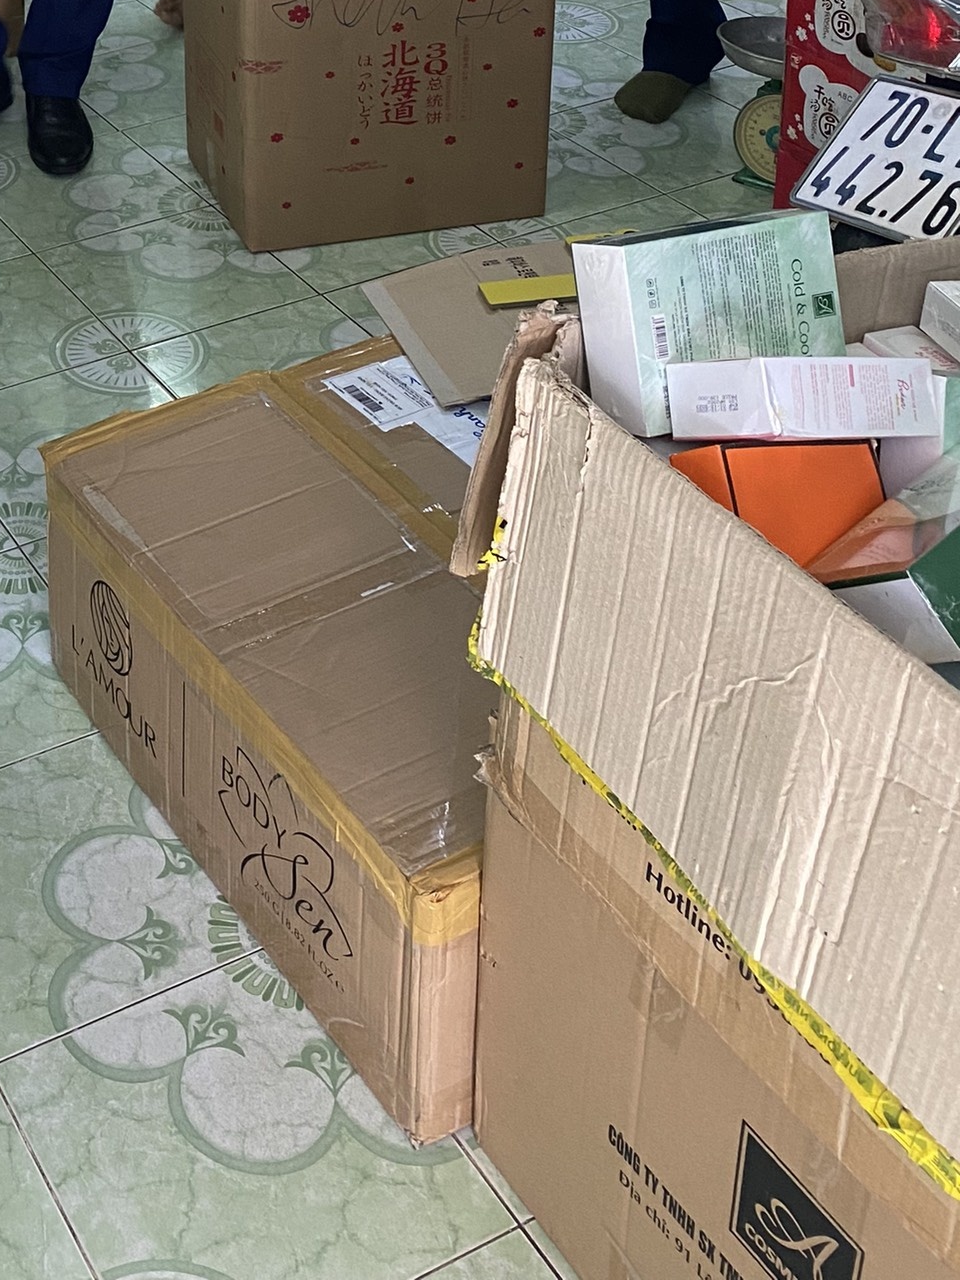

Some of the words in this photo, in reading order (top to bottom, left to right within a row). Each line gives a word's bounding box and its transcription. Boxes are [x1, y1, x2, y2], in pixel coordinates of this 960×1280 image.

[378, 40, 421, 126] 北海道
[423, 42, 449, 76] 3Q
[426, 76, 444, 125] 总统饼
[860, 90, 960, 168] 70-L
[790, 258, 806, 297] Cold
[796, 303, 808, 316] &
[798, 321, 813, 358] Coo
[72, 624, 157, 760] L'AMOUR
[222, 755, 287, 849] BODY
[644, 861, 732, 961] Hotline:
[608, 1123, 641, 1176] CÔNG
[644, 1164, 659, 1195] TY
[662, 1185, 696, 1240] TNHH
[698, 1229, 717, 1265] SX
[619, 1170, 642, 1206] Địa
[645, 1204, 671, 1240] chỉ:
[674, 1236, 691, 1264] 91
[745, 1222, 800, 1280] COSM
